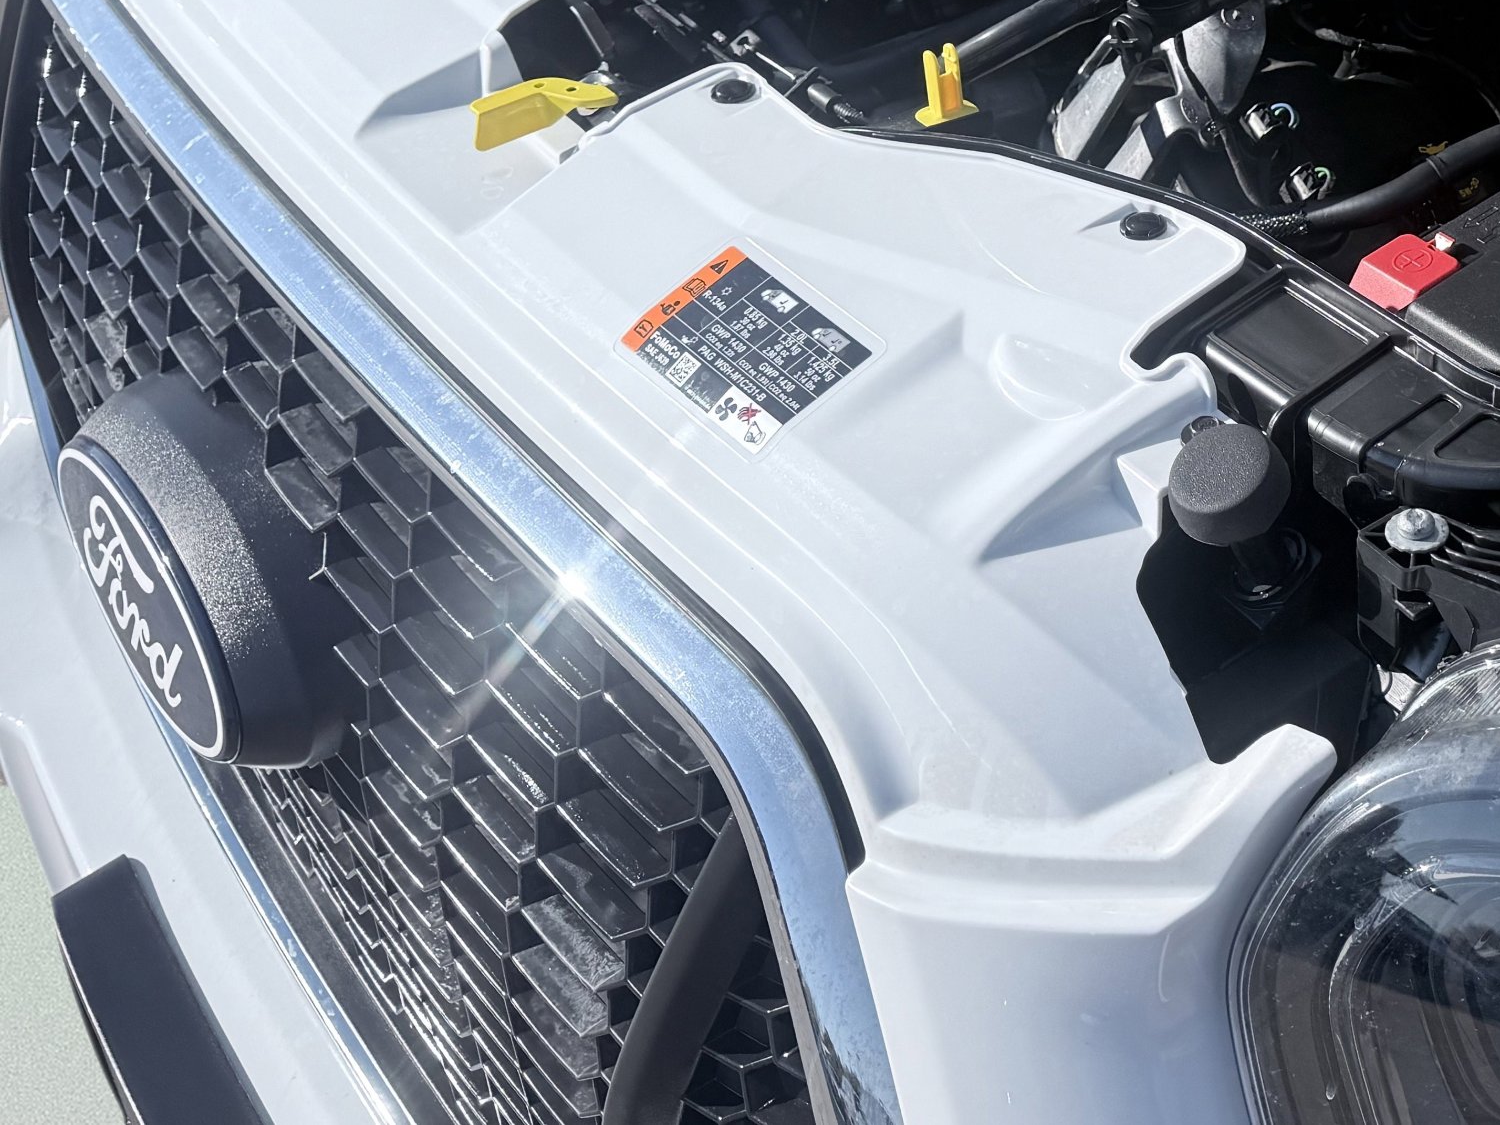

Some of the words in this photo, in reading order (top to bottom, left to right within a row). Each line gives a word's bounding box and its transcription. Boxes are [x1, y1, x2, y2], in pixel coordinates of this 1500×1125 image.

[702, 290, 726, 310] R-134a
[743, 307, 759, 320] 0.85
[755, 317, 767, 328] kg
[649, 331, 681, 357] FoMoCo
[711, 323, 730, 339] GWP
[728, 337, 745, 352] 1430
[778, 334, 793, 347] 1.35
[788, 343, 801, 354] kg
[790, 328, 807, 342] 2.0L
[644, 343, 657, 355] SAE
[697, 345, 715, 359] PAG
[773, 355, 783, 364] lbs
[807, 357, 826, 373] 1.425
[821, 369, 835, 381] kg
[822, 353, 839, 367] 3.5L
[758, 361, 778, 378] GWP
[776, 376, 794, 391] 1430
[804, 380, 815, 389] lbs
[768, 383, 780, 394] CO2
[83, 495, 183, 708] Ford
